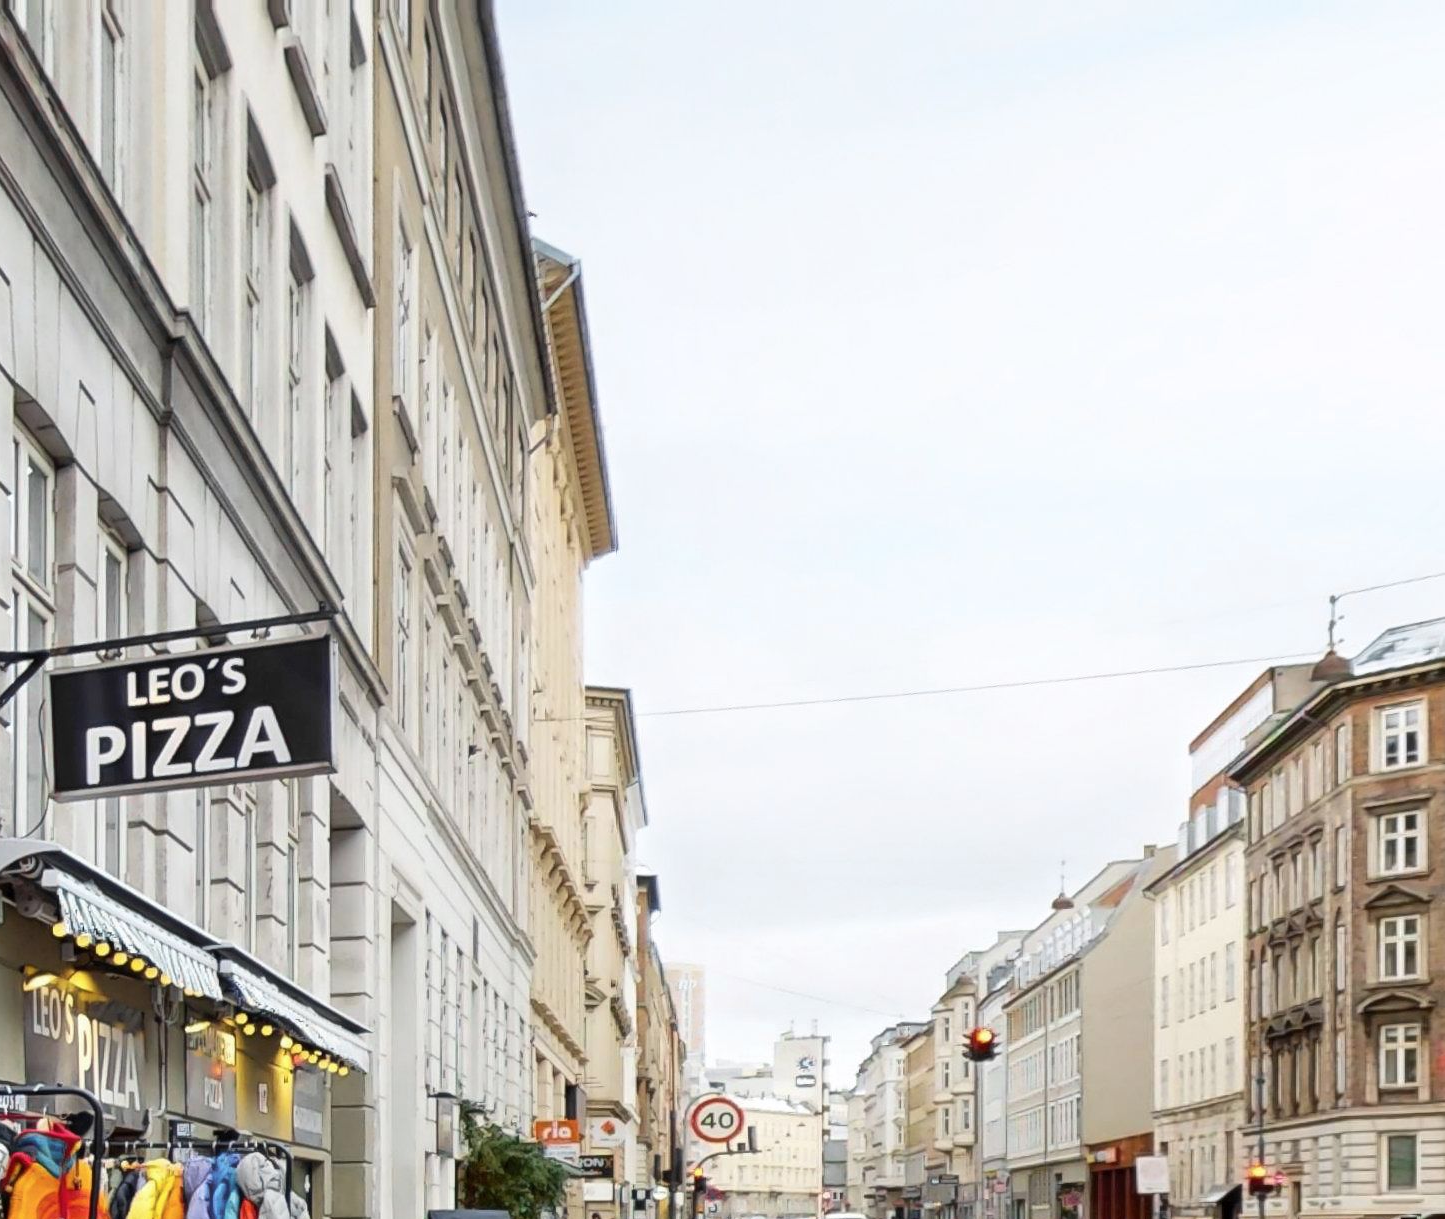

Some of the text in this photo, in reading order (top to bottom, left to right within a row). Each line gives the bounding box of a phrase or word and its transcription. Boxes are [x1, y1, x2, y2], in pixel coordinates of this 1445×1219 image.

[86, 705, 292, 786] PIZZA
[77, 1013, 140, 1112] PIZZA
[700, 1111, 734, 1130] 40
